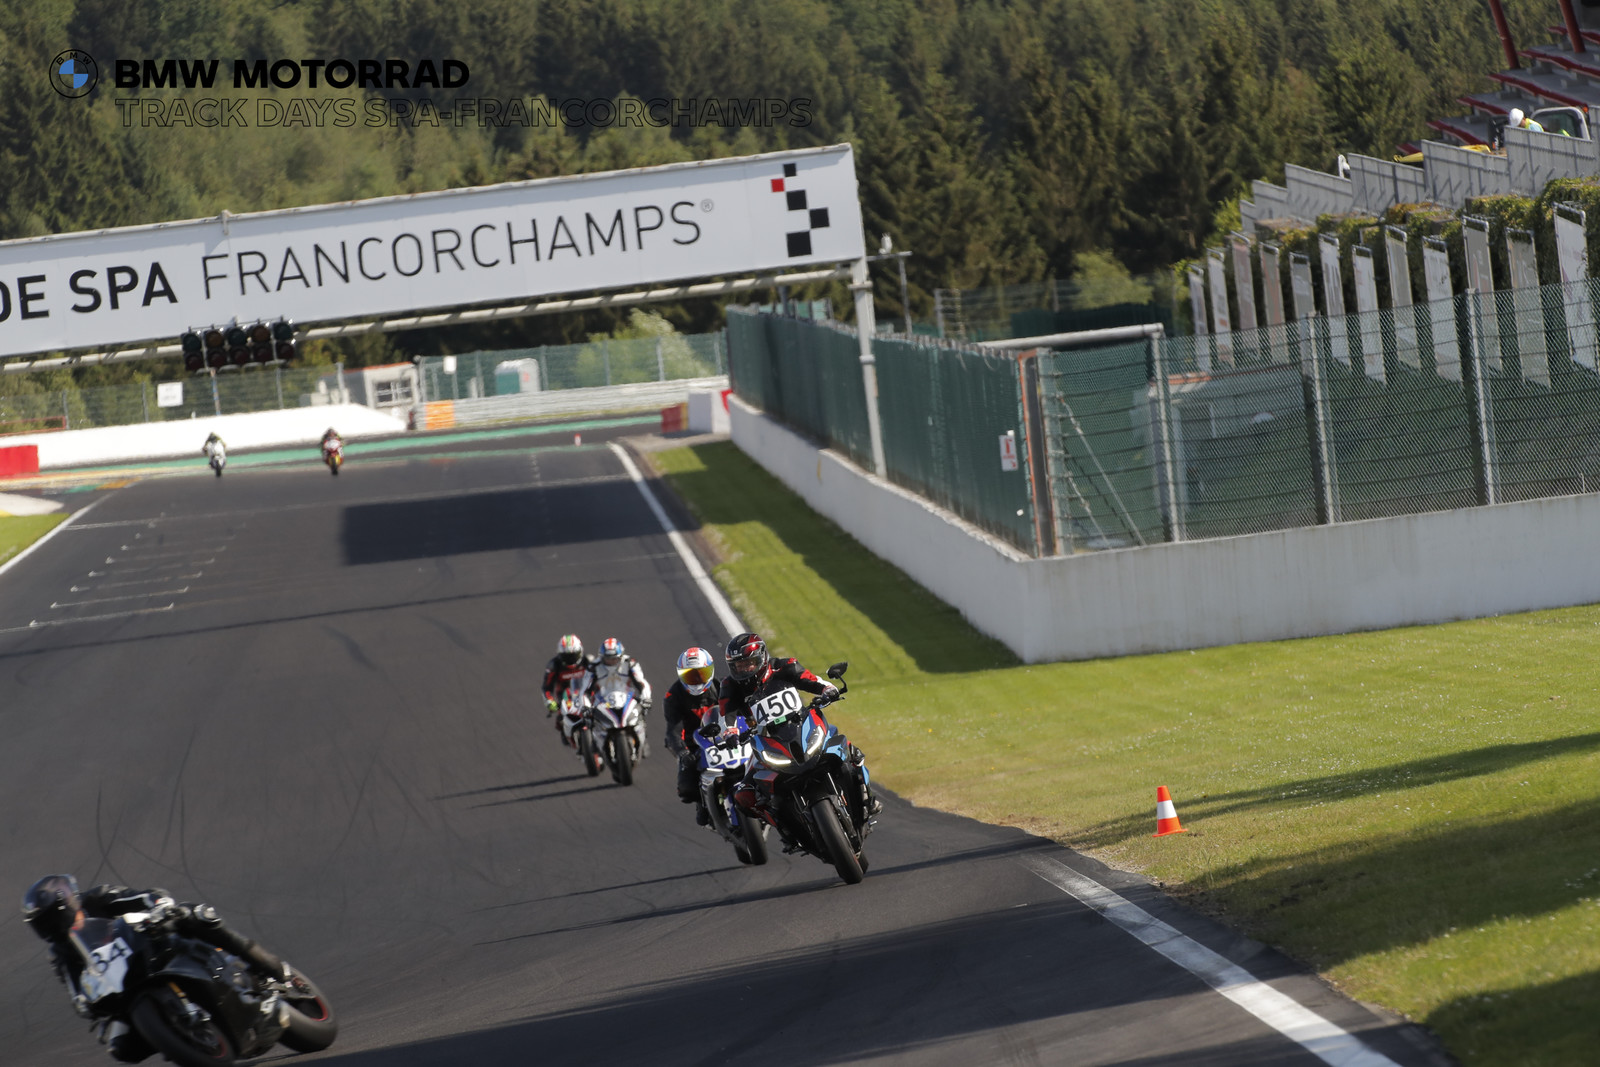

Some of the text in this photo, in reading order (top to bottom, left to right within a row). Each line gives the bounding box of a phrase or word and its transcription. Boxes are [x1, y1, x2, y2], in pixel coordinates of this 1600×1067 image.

[69, 261, 179, 314] SPA
[201, 201, 702, 300] FRANCORCHAMPS
[756, 690, 798, 725] 450
[91, 942, 126, 974] 34
